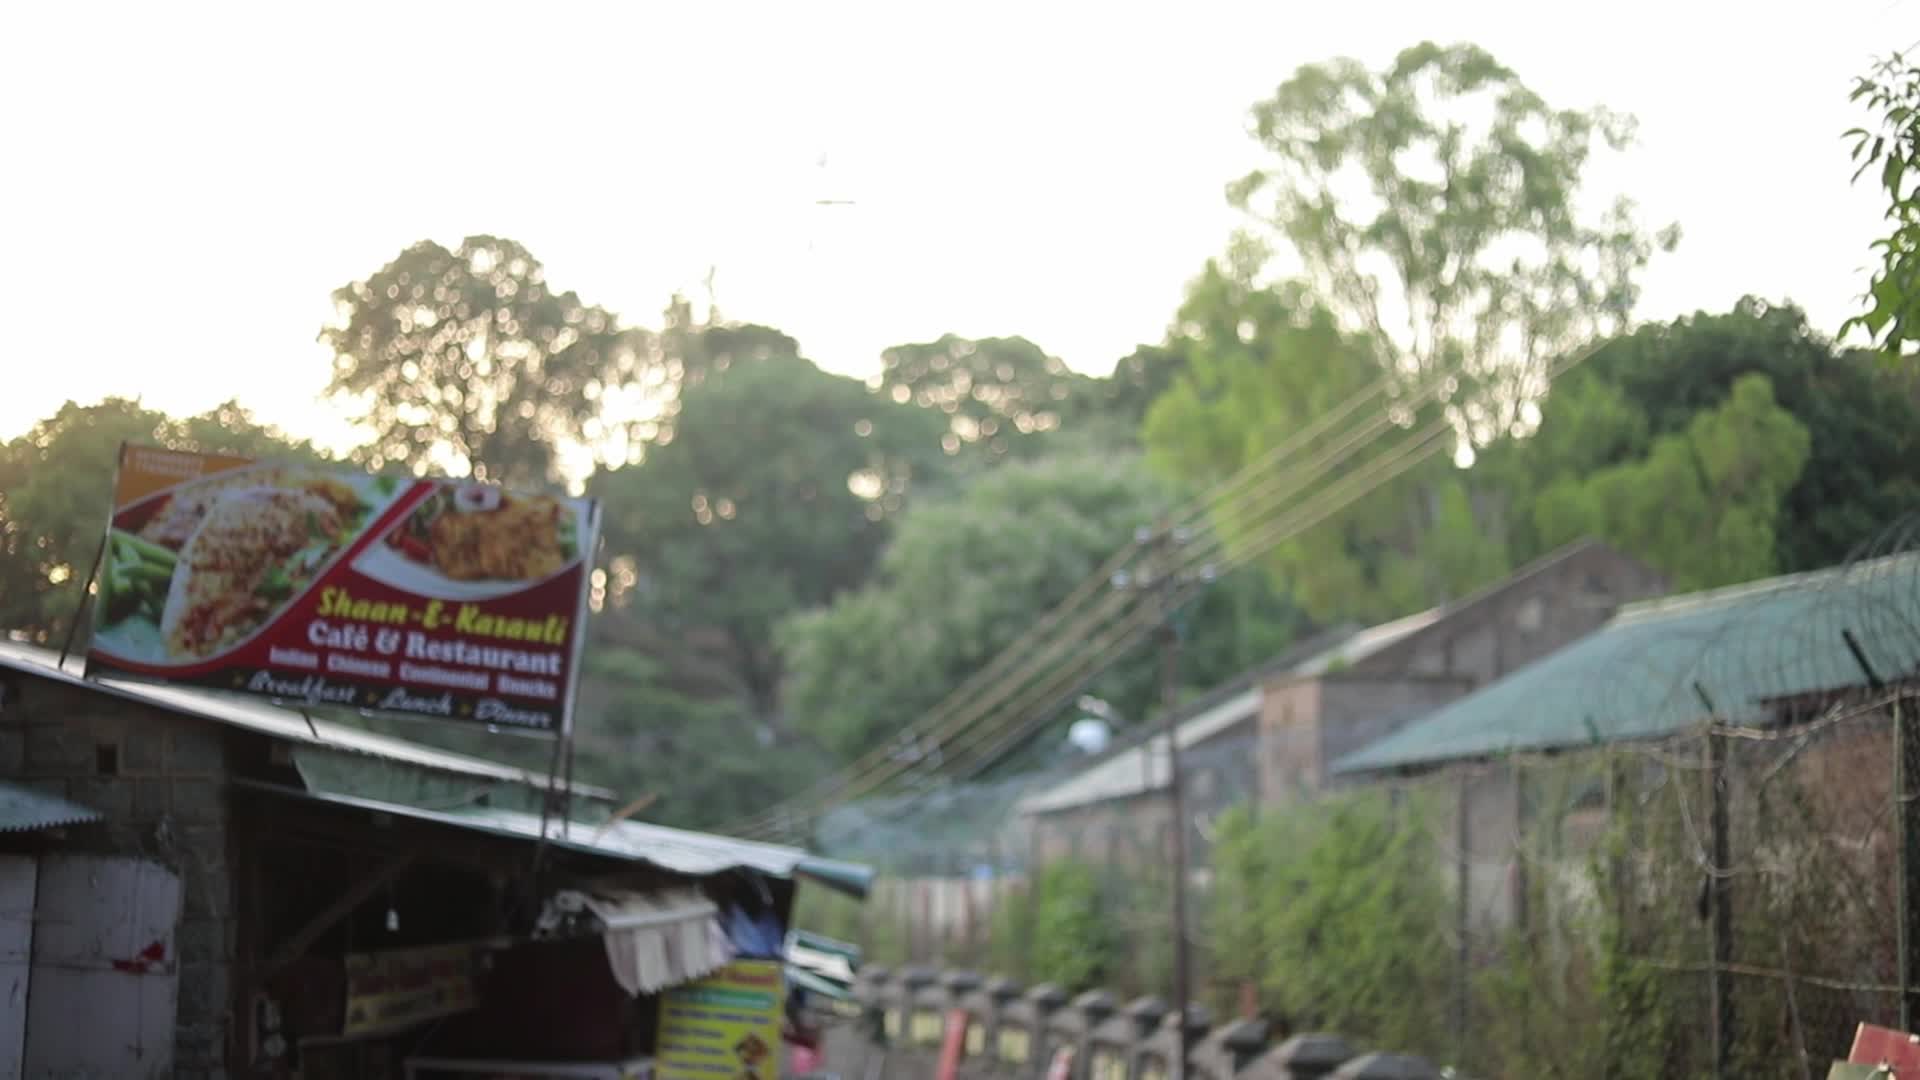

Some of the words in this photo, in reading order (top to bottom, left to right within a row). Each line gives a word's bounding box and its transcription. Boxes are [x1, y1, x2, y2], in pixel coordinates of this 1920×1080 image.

[307, 619, 368, 651] Café
[375, 628, 398, 655] &
[404, 631, 562, 675] Restaurant
[247, 669, 357, 706] Breakfast
[379, 688, 453, 716] Lunch
